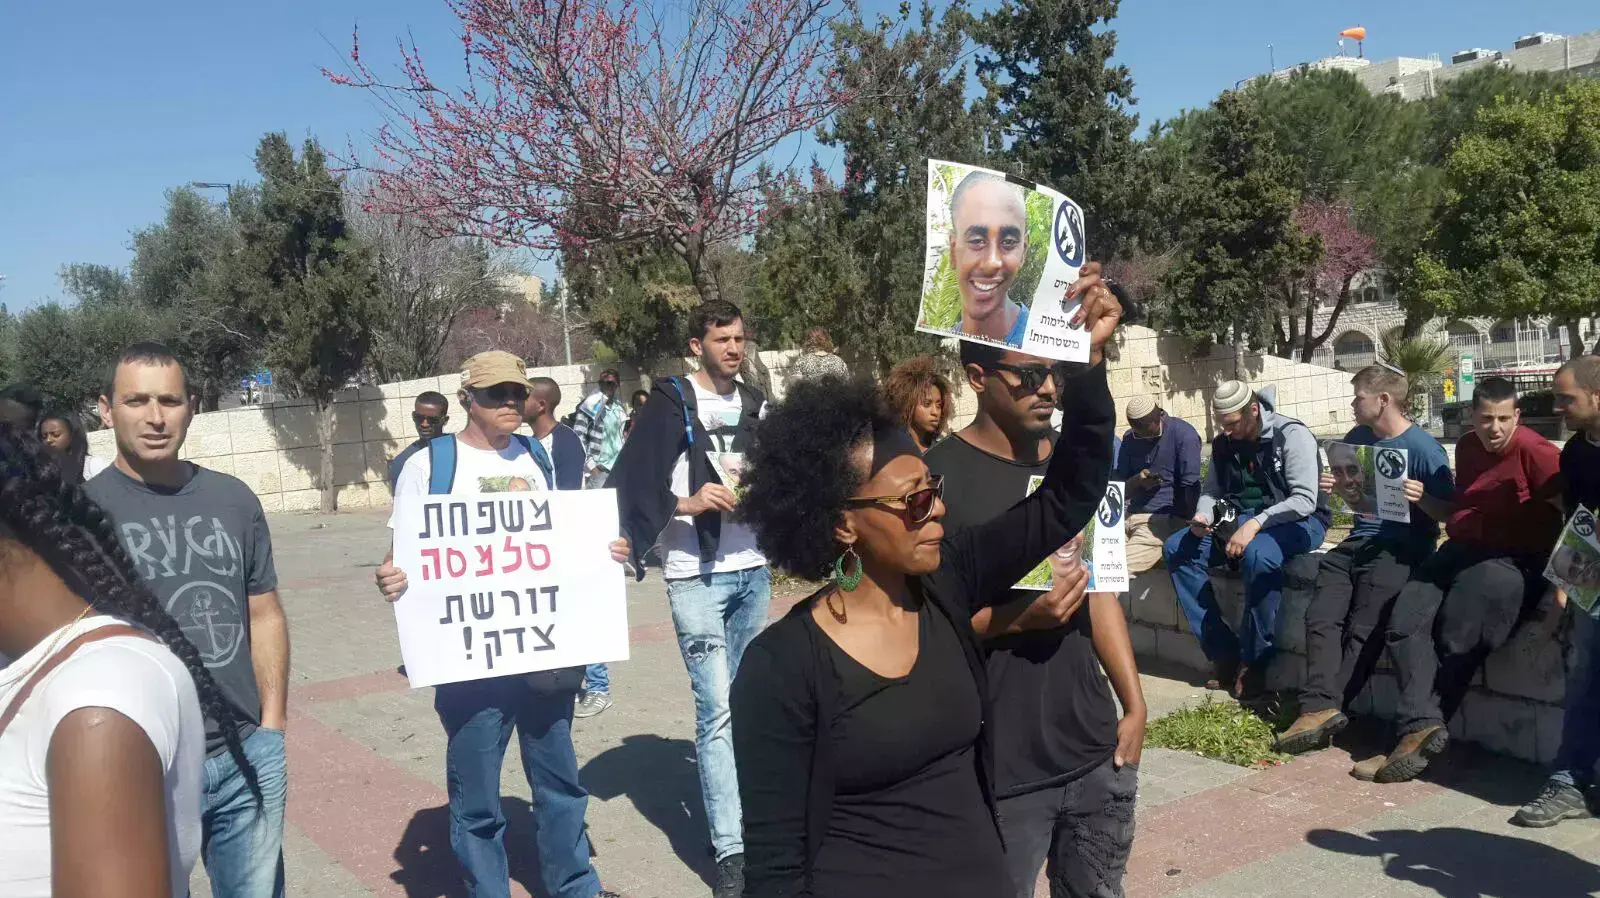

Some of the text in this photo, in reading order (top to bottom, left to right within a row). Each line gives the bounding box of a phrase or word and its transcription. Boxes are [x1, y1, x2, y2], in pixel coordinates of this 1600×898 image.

[1029, 329, 1080, 349] משטרתית!
[1040, 315, 1073, 329] אלימות
[419, 499, 553, 538] משפחת
[421, 536, 551, 580] סלמסה
[439, 585, 559, 624] דורשת
[463, 624, 556, 670] צדק!
